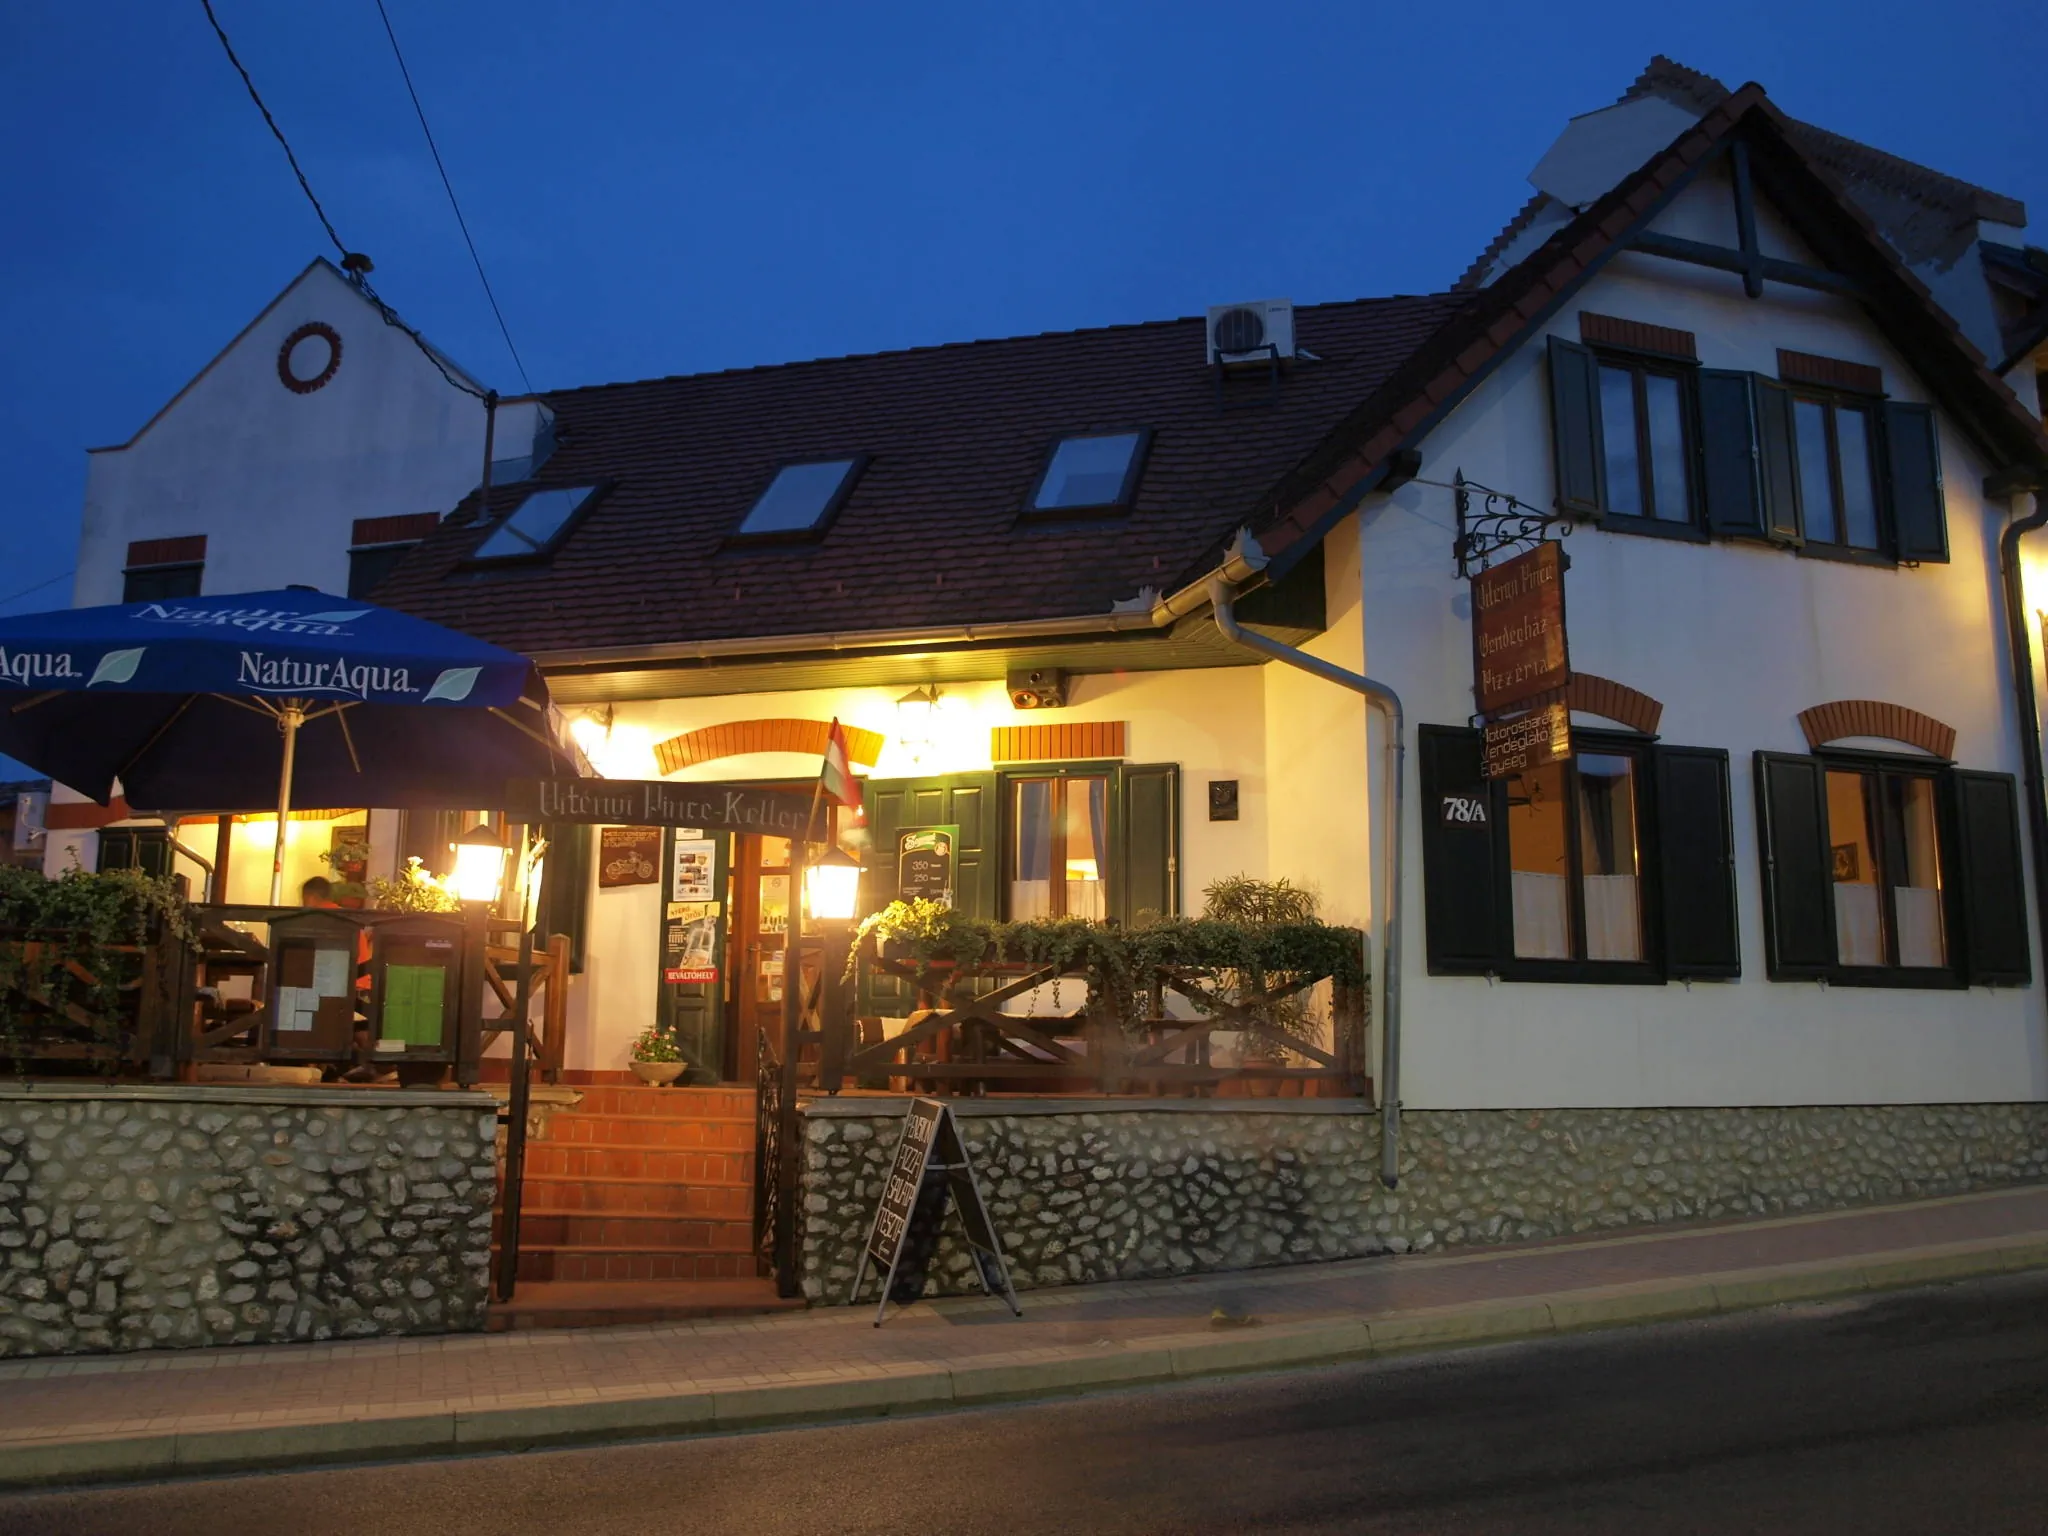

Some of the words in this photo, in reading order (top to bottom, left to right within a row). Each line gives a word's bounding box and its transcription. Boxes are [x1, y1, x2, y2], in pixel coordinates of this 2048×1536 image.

[129, 603, 300, 619] Natur
[237, 651, 412, 700] NaturAqua
[1443, 796, 1486, 822] 78/A
[896, 1144, 923, 1178] PIZZA
